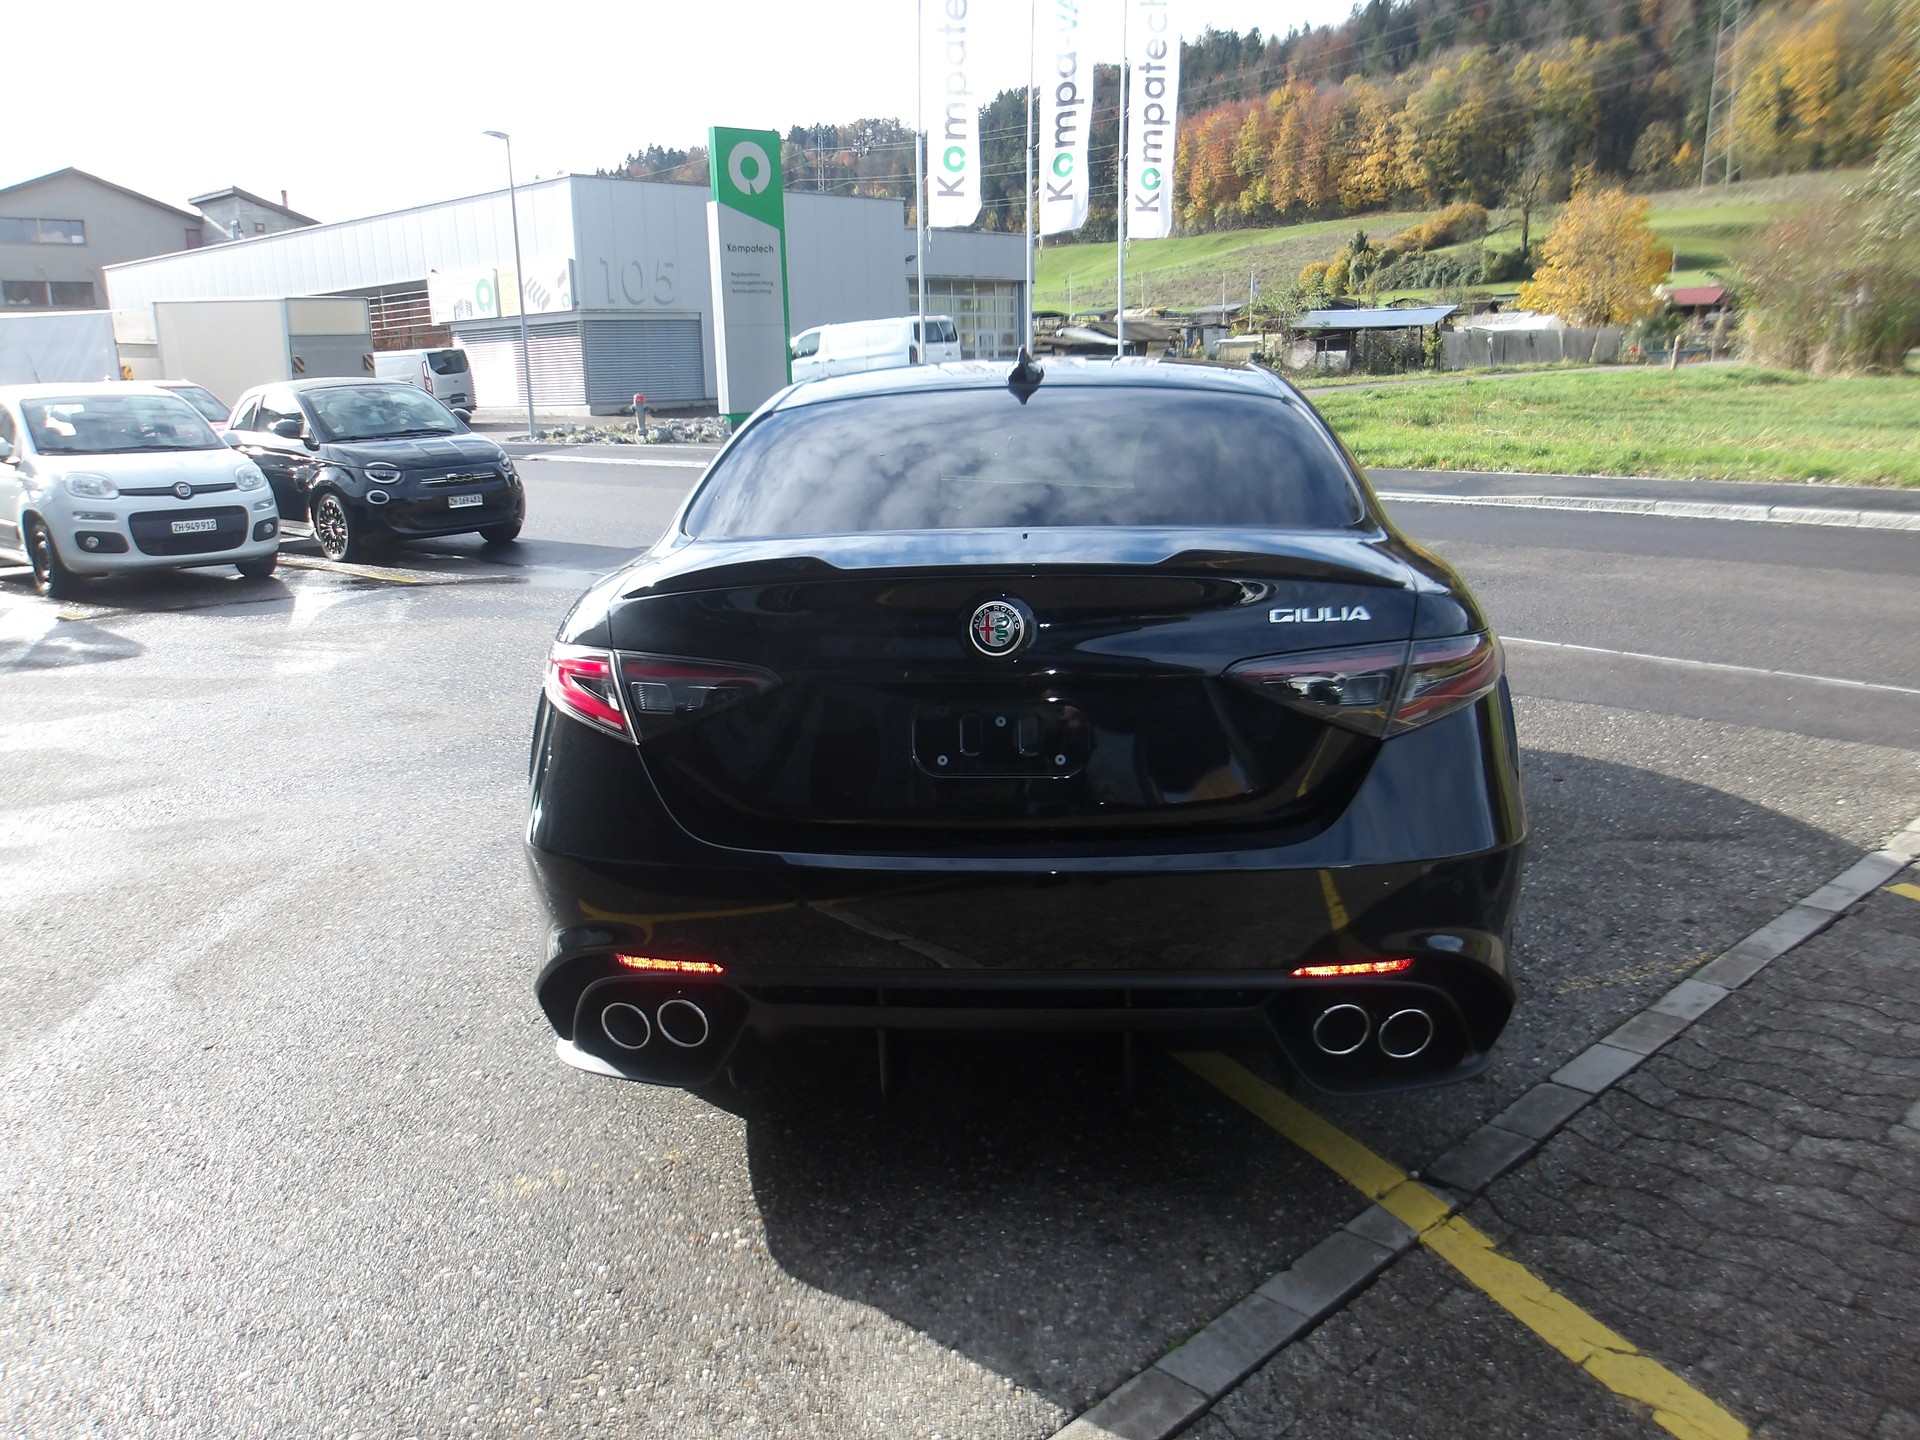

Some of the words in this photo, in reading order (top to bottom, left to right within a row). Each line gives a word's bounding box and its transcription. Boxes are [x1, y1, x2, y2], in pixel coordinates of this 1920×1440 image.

[727, 243, 774, 254] Kompatech
[599, 256, 676, 305] 105
[974, 608, 990, 630] ALFA
[993, 605, 1020, 630] ROMEO
[1269, 605, 1372, 623] GIULIA
